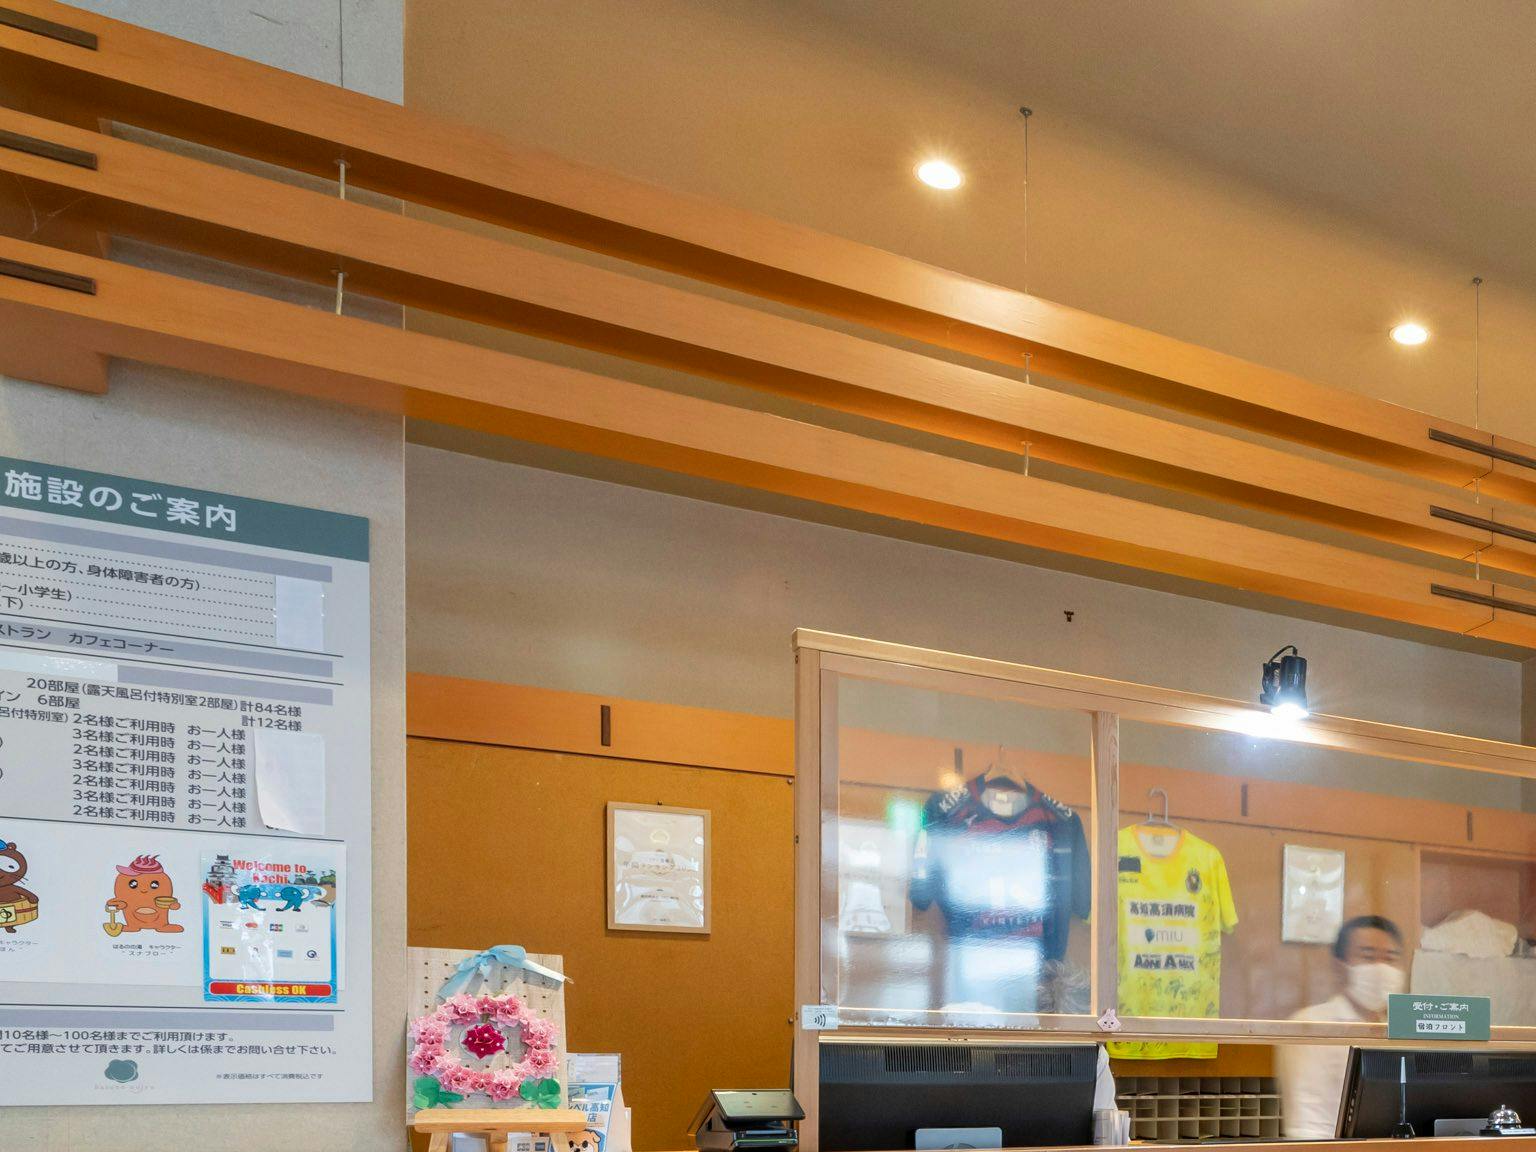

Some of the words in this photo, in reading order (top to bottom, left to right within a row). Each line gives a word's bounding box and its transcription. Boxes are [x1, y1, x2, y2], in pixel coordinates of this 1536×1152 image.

[4, 469, 237, 532] 施設のご案内
[0, 583, 72, 602] 〜小学生)
[68, 632, 175, 653] カフェコーナー
[37, 694, 81, 710] 6部屋
[240, 699, 303, 719] 計84名様
[72, 713, 176, 734] 2名様ご利用時
[187, 724, 247, 741] お一人様
[241, 714, 303, 732] 計12名様
[72, 728, 176, 749] 3名様ご利用時
[187, 739, 247, 756] お一人様
[72, 743, 176, 764] 2名様ご利用時
[187, 754, 247, 770] お一人様
[72, 759, 176, 779] 3名様ご利用時
[187, 769, 247, 785] お一人様
[72, 774, 176, 794] 2名様ご利用時
[187, 784, 247, 800] お一人様
[72, 789, 176, 809] 3名様ご利用時
[187, 799, 247, 814] お一人様
[72, 805, 176, 824] 2名様ご利用時
[187, 813, 247, 829] お一人様
[233, 859, 291, 873] Welcome
[294, 863, 308, 874] to
[236, 984, 290, 995] Cashless
[291, 985, 307, 995] OK
[1412, 1001, 1470, 1012] 受付・ご案内
[0, 1030, 234, 1042] 10名様〜100名様までご利用頂けます。
[1417, 1022, 1464, 1031] 宿泊フロント
